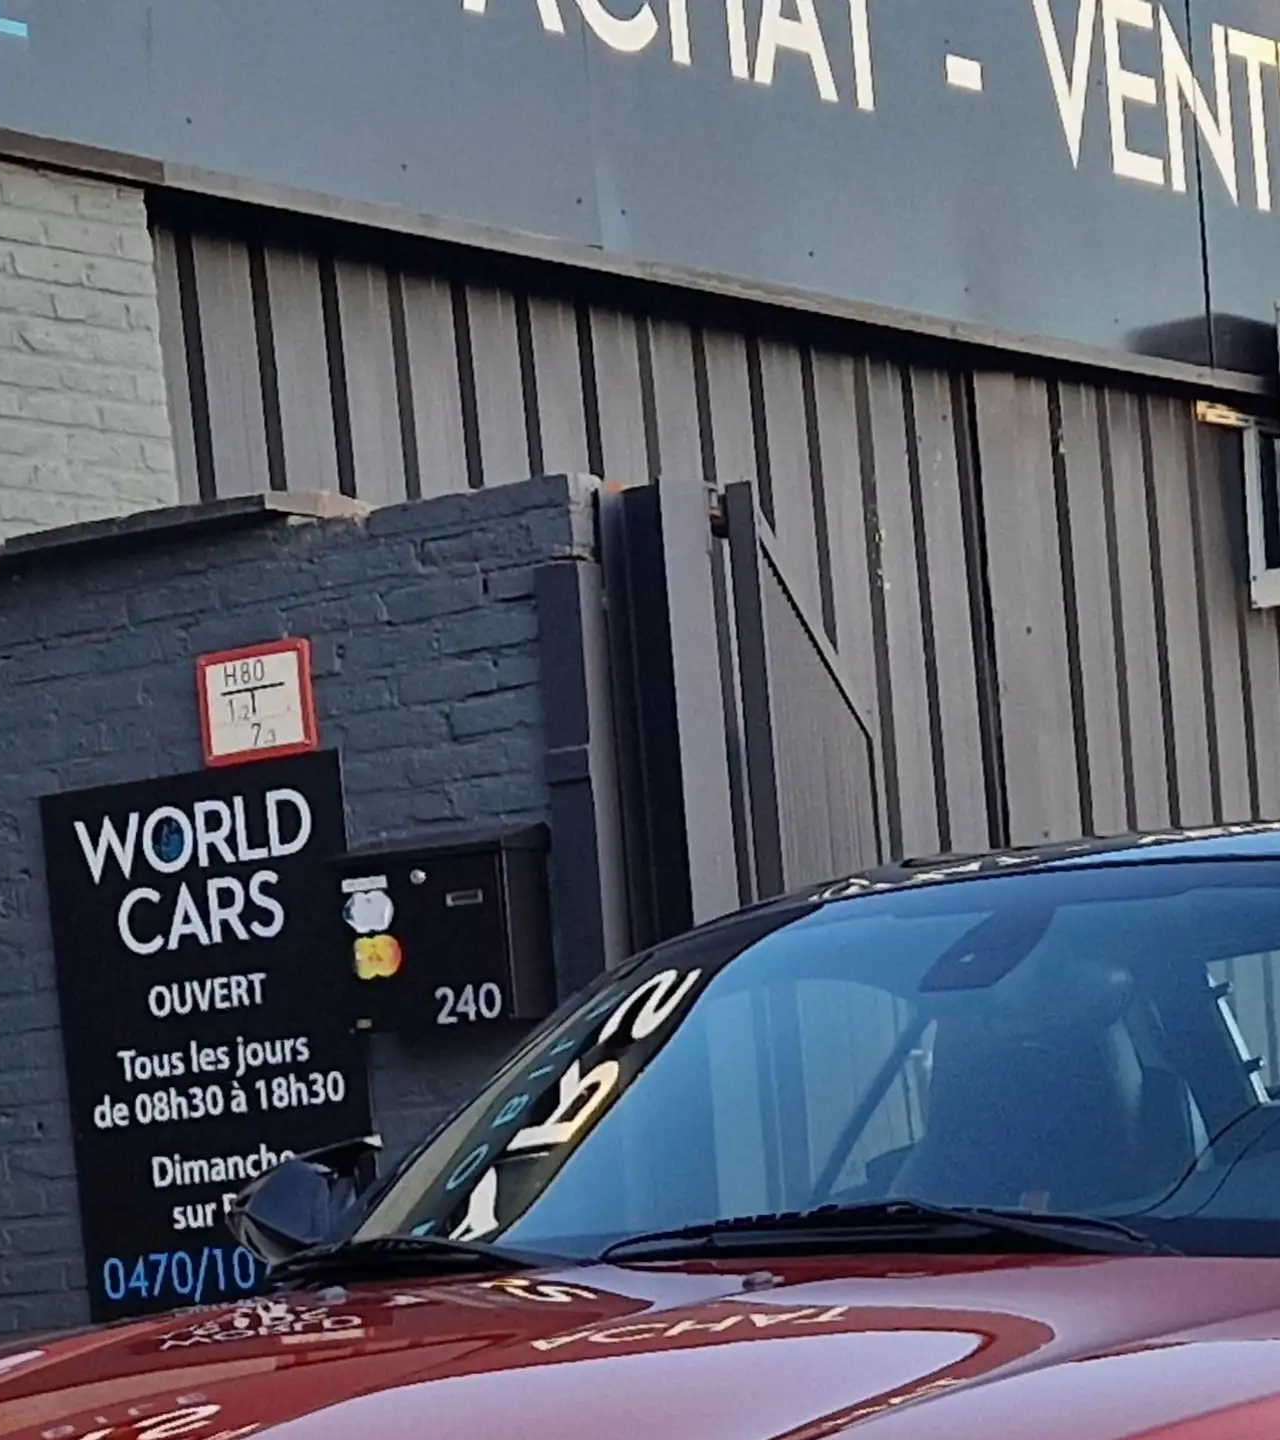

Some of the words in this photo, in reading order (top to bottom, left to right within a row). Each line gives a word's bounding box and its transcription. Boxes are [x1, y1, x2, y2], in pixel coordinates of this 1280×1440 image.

[223, 659, 265, 688] H80
[74, 788, 312, 885] WORLD
[117, 870, 284, 955] CARS
[148, 972, 267, 1018] OUVERT
[434, 981, 503, 1025] 240
[117, 1049, 186, 1082] Tous
[190, 1040, 231, 1073] les
[235, 1035, 310, 1077] jours
[93, 1094, 129, 1129] de
[135, 1084, 224, 1125] 08h30
[230, 1079, 249, 1114] à
[255, 1070, 346, 1111] 18h30
[173, 1200, 217, 1230] sur
